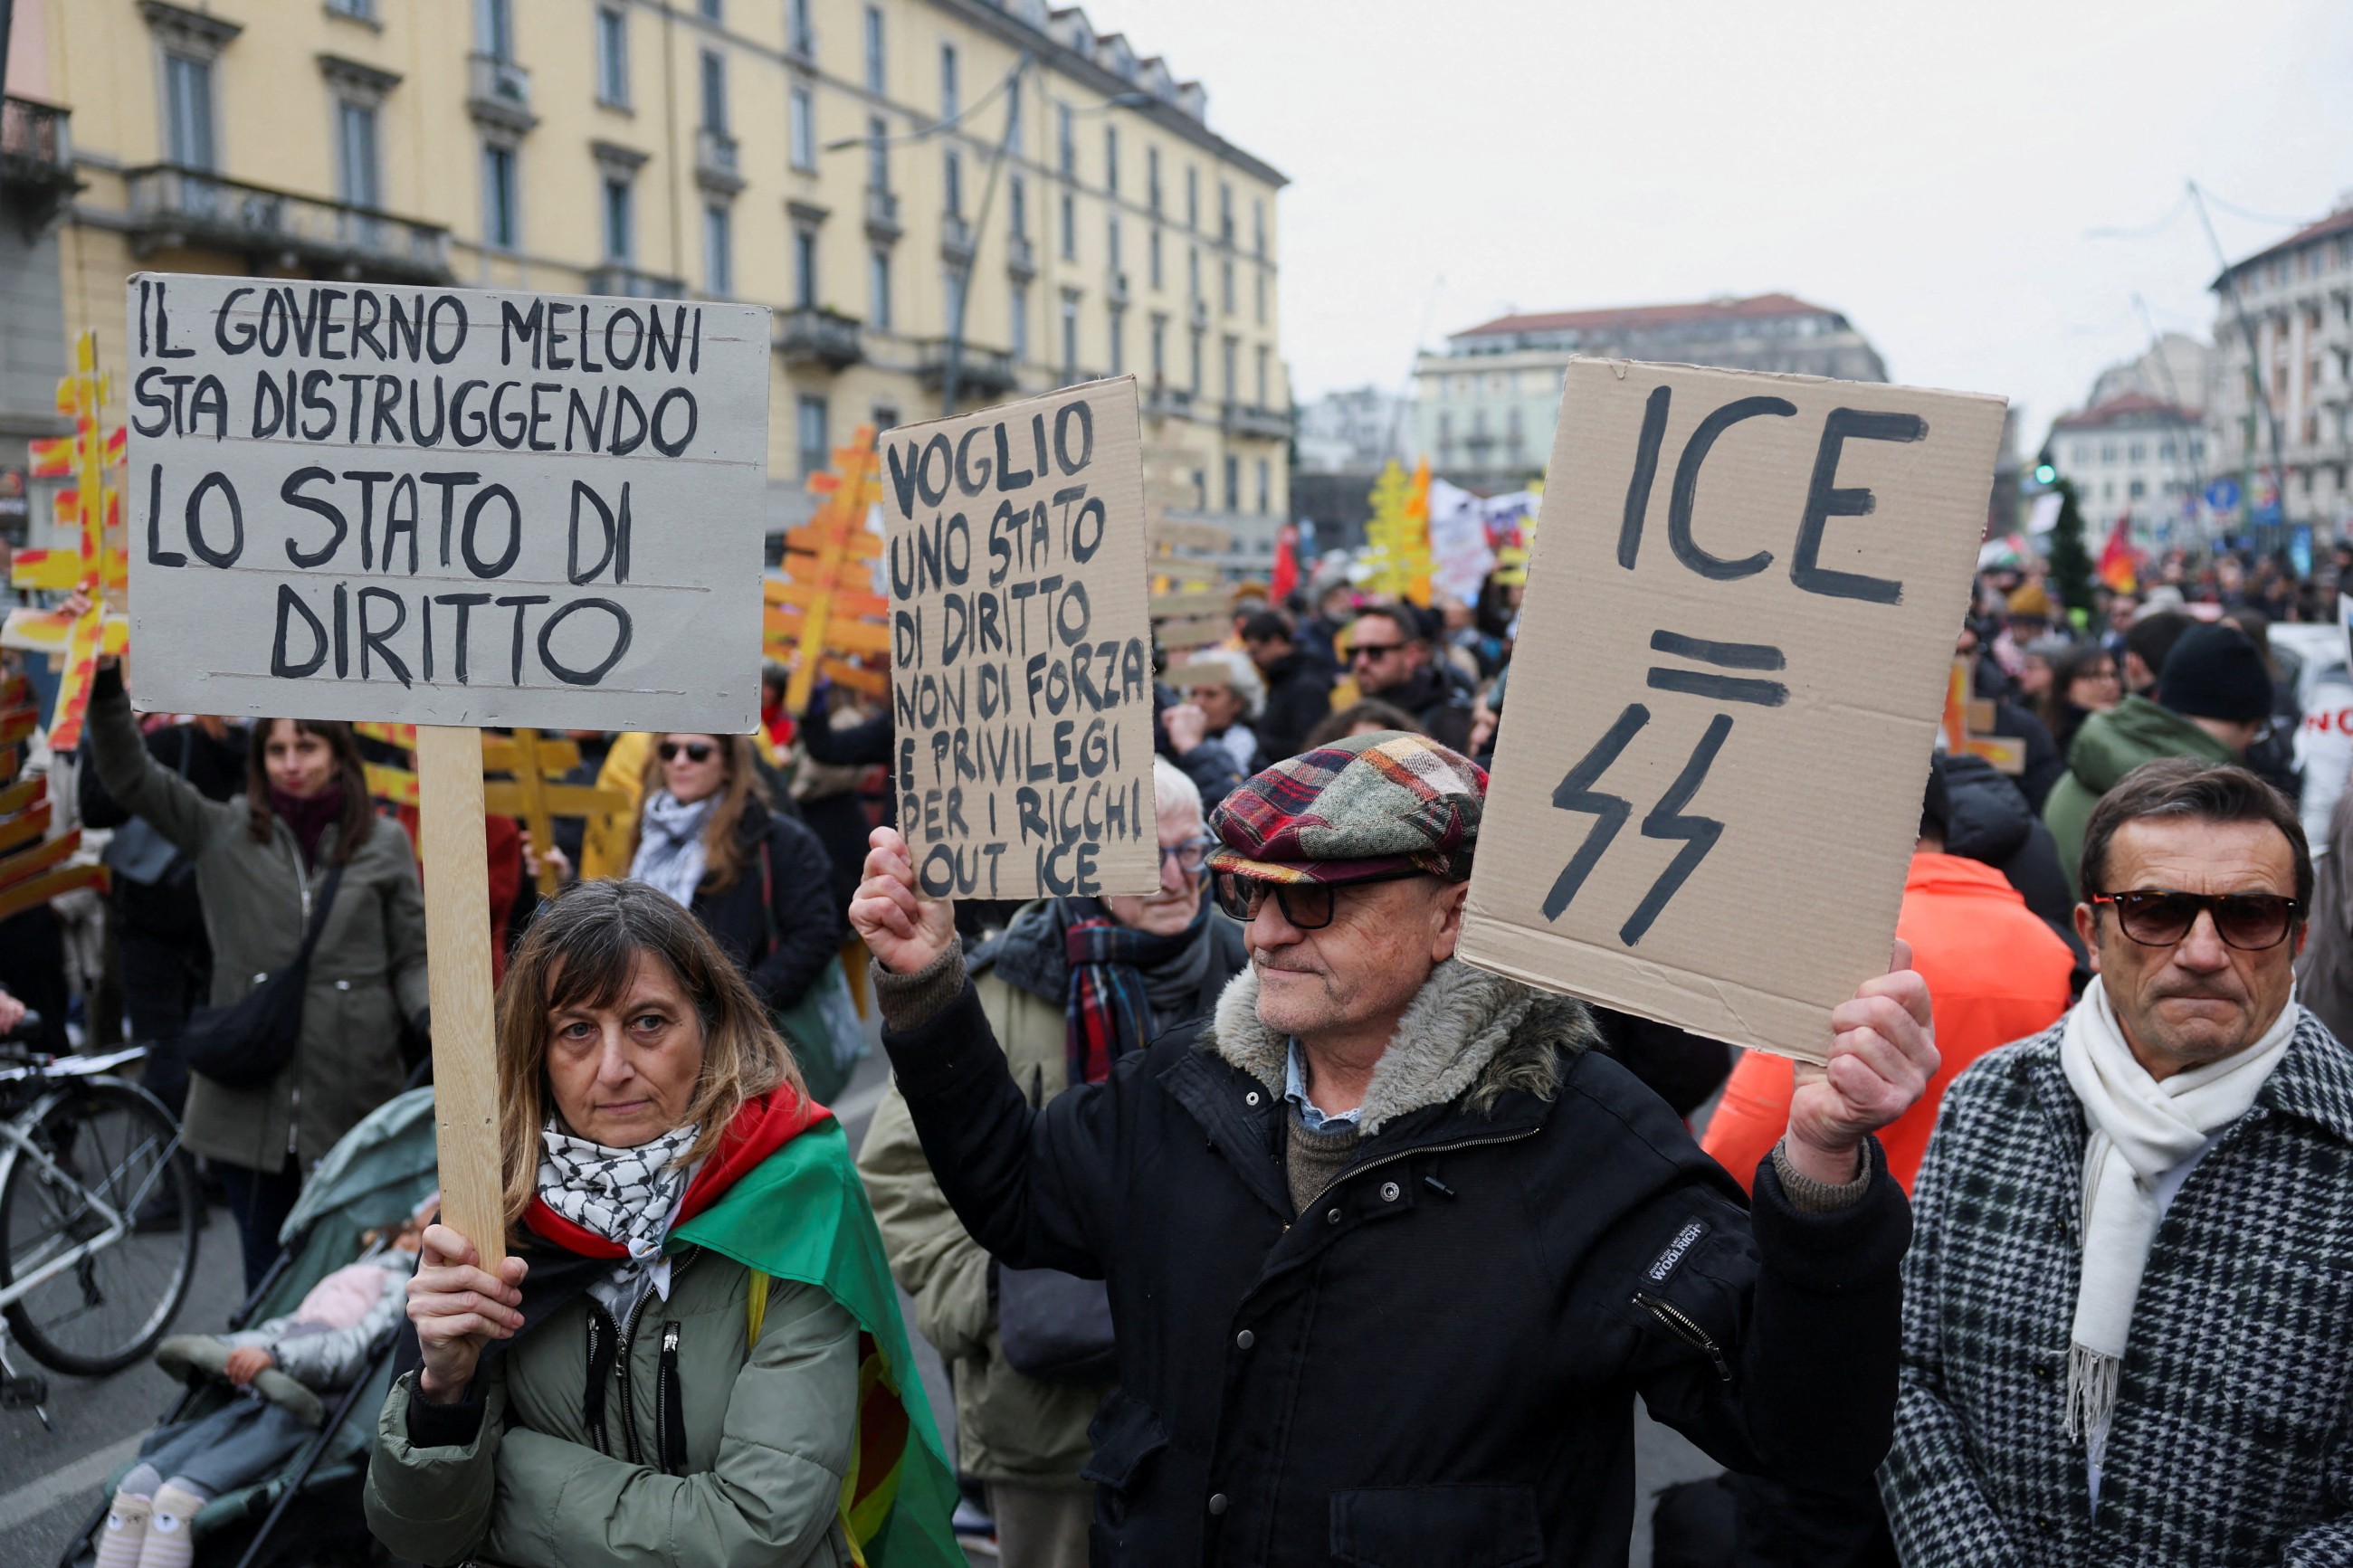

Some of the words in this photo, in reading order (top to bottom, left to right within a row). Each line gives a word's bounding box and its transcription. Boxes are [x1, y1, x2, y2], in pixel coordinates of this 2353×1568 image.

[140, 280, 196, 358] IL
[214, 286, 470, 364] GOVERNO
[500, 299, 702, 374] MELONI
[130, 366, 229, 442] STA
[251, 367, 700, 458] DISTRUGGENDO
[887, 399, 1094, 520] VOGLIO
[147, 462, 244, 568] LO
[279, 465, 523, 579] STATO
[566, 480, 632, 585] DI
[891, 510, 971, 601] UNO
[988, 483, 1106, 589] STATO
[1616, 385, 1930, 606] ICE
[270, 581, 633, 689] DIRITTO
[895, 604, 923, 671] DI
[942, 574, 1091, 667] DIRITTO
[897, 665, 966, 731] NON
[977, 660, 1012, 722] DI
[1026, 636, 1145, 720] FORZA
[900, 736, 916, 793] E
[931, 719, 1120, 787] PRIVILEGI
[903, 785, 969, 844] PER
[988, 791, 996, 838] I
[1015, 776, 1142, 847] RICCHI
[919, 841, 1008, 899] OUT
[1035, 841, 1102, 898] ICE
[1649, 1261, 1661, 1277] JOHN
[1660, 1248, 1672, 1261] RICH
[1671, 1237, 1681, 1248] AND
